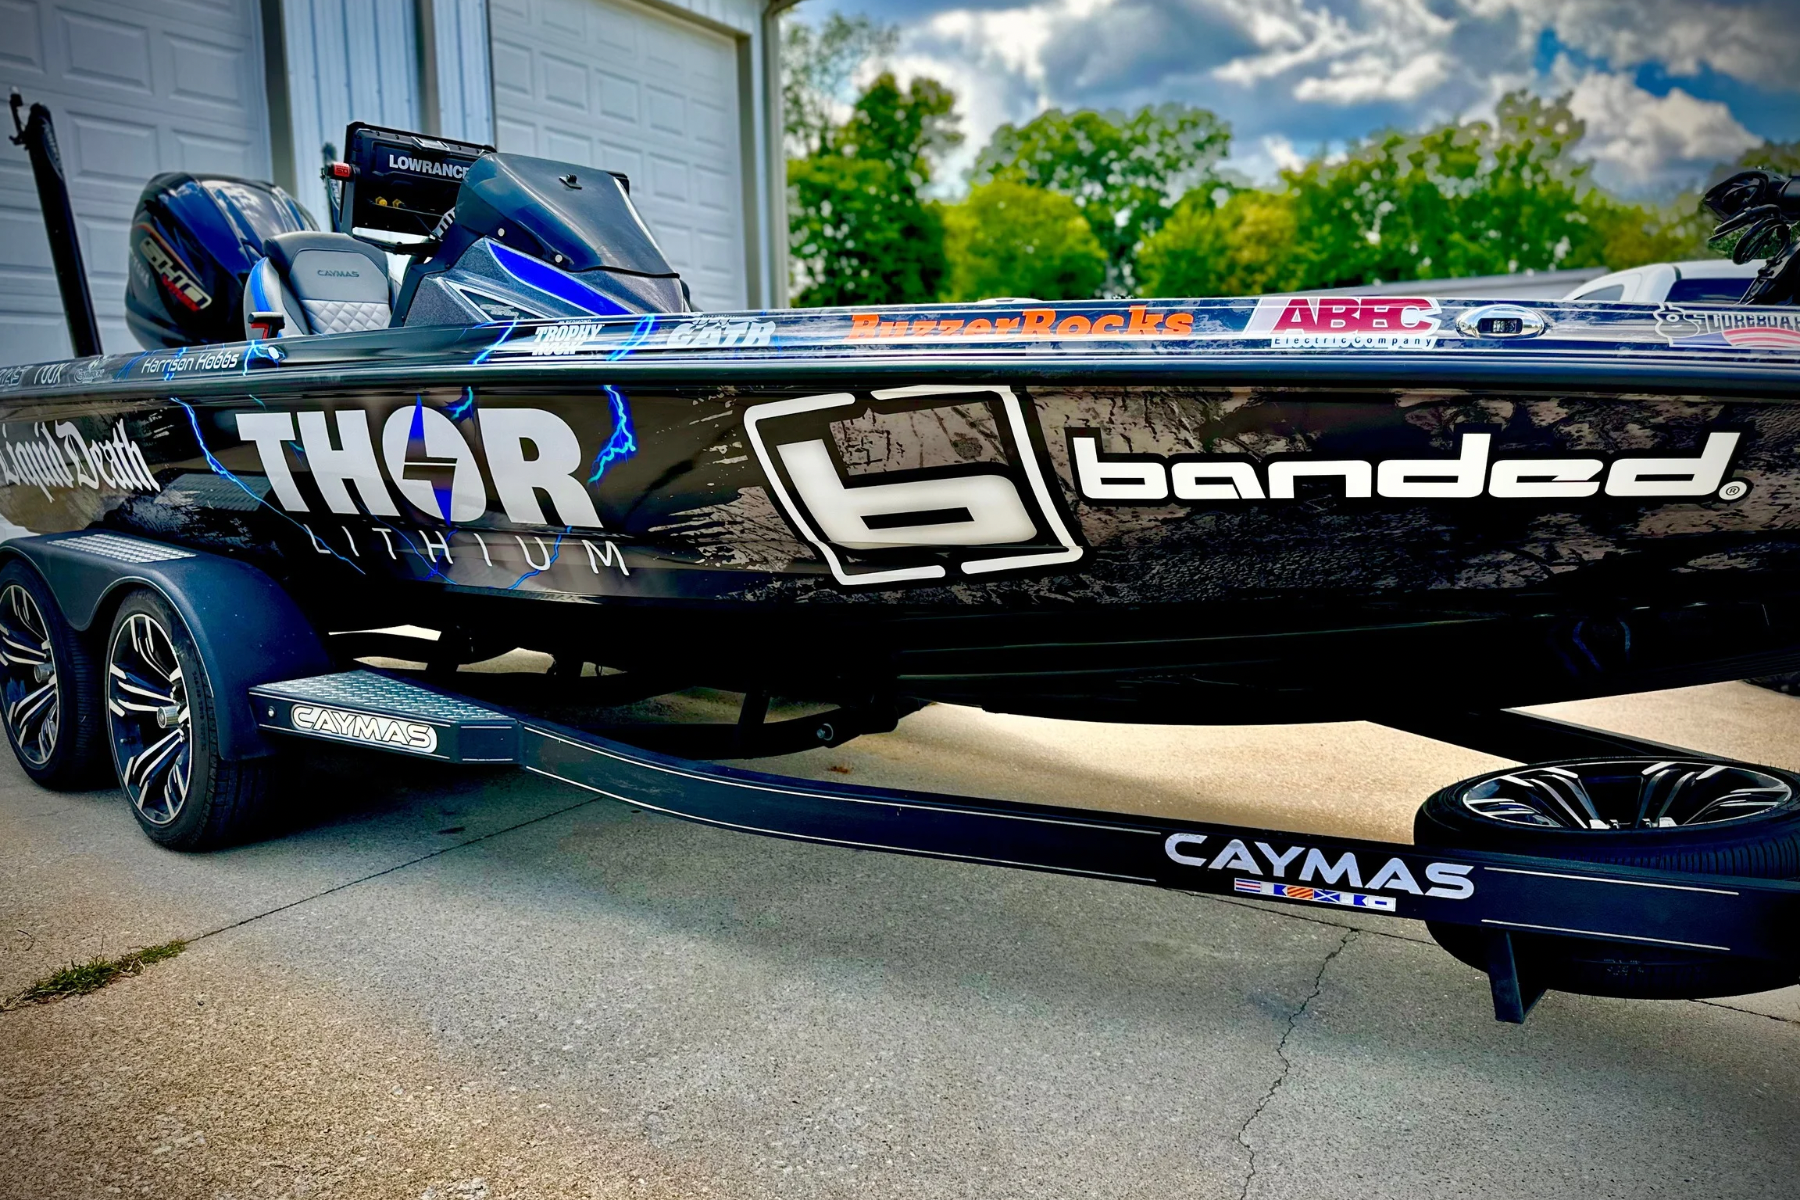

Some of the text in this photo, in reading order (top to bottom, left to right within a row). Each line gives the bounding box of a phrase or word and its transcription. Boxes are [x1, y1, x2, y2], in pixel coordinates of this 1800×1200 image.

[317, 270, 360, 278] CAYMAS
[534, 324, 603, 343] TROPHY
[141, 350, 240, 374] Harrison Hobbs
[0, 418, 161, 503] Liquid Death
[235, 404, 603, 528] THOR
[303, 523, 630, 576] LITHIUM
[291, 703, 433, 749] CAYMAS
[1164, 832, 1475, 900] CAYMAS
